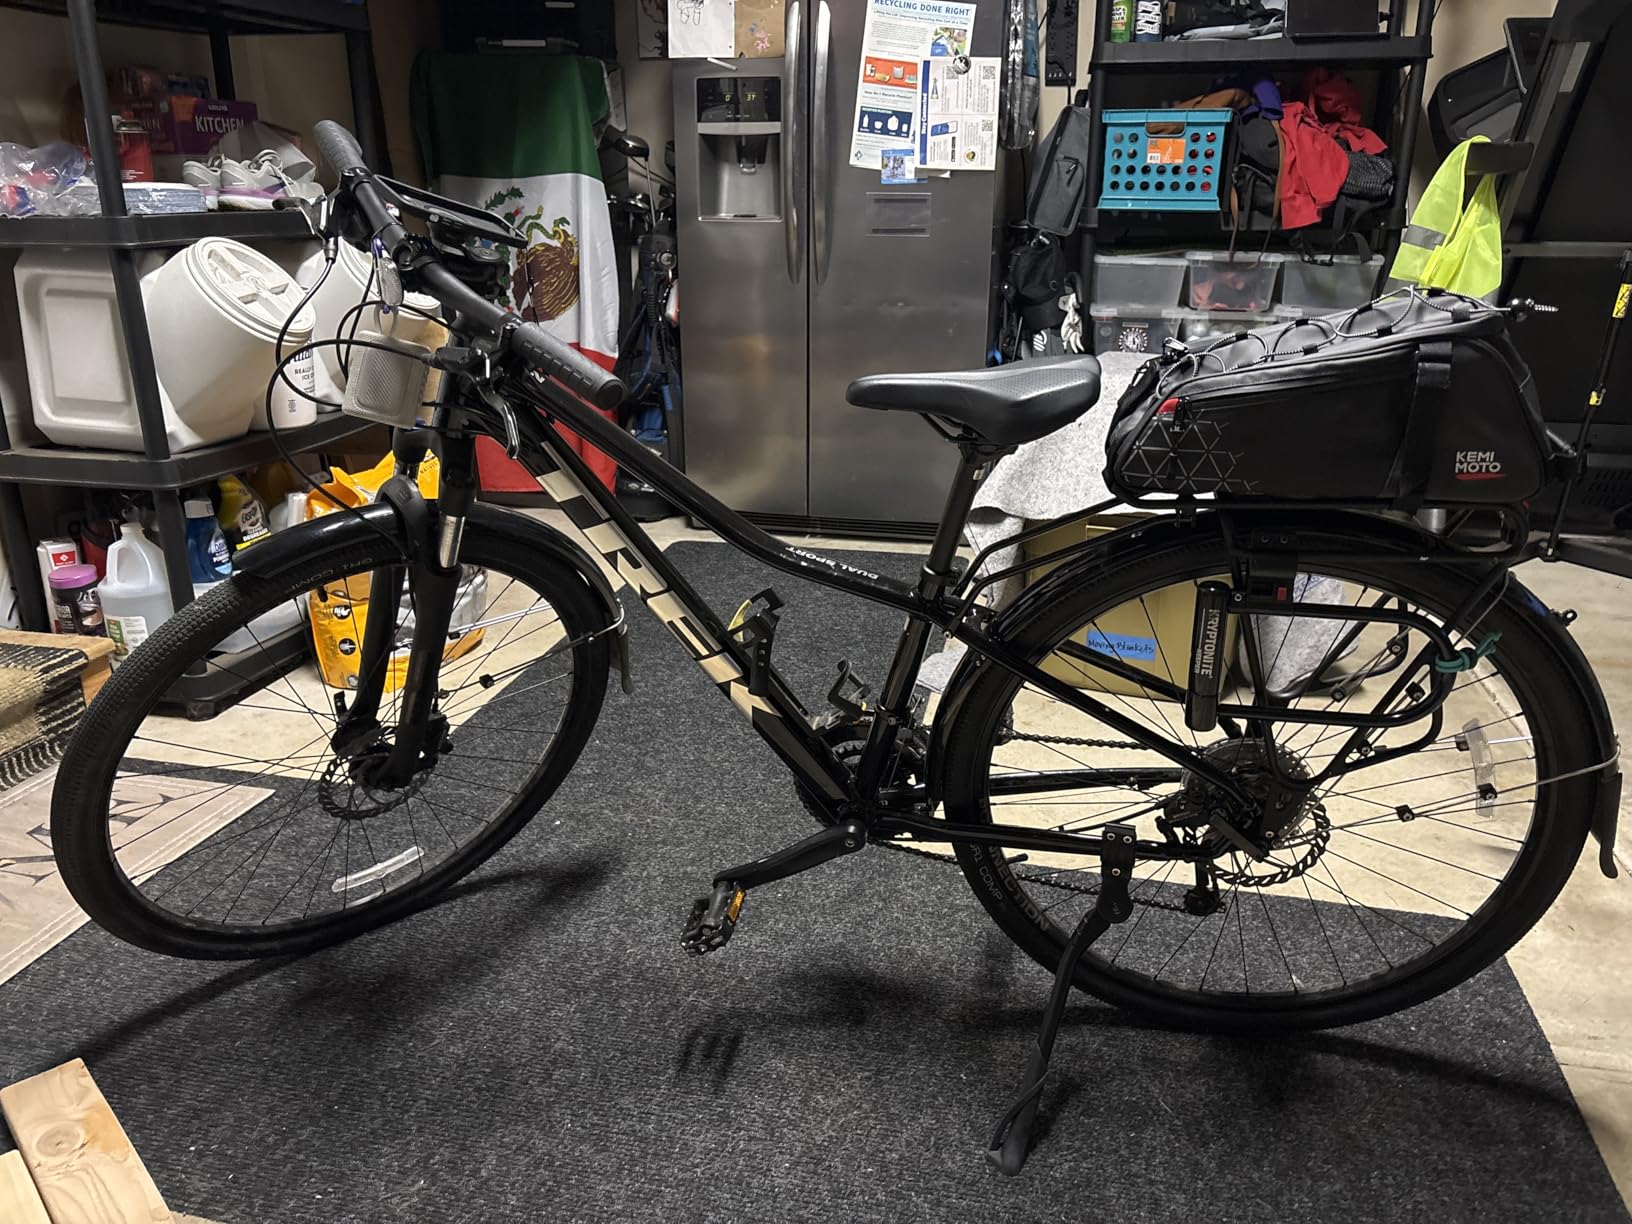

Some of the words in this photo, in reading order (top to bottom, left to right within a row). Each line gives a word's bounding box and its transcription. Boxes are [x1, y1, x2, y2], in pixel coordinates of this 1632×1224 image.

[874, 0, 917, 10] RECYCLING
[920, 4, 942, 13] DONE
[945, 6, 970, 16] RIGHT
[194, 115, 244, 132] KITCHEN
[1455, 450, 1495, 462] KEMI
[1455, 462, 1501, 473] MOTO
[785, 547, 836, 569] SPORT
[839, 563, 879, 580] DUAL
[1201, 608, 1221, 677] KRYPTONITE
[979, 866, 1003, 900] COMP
